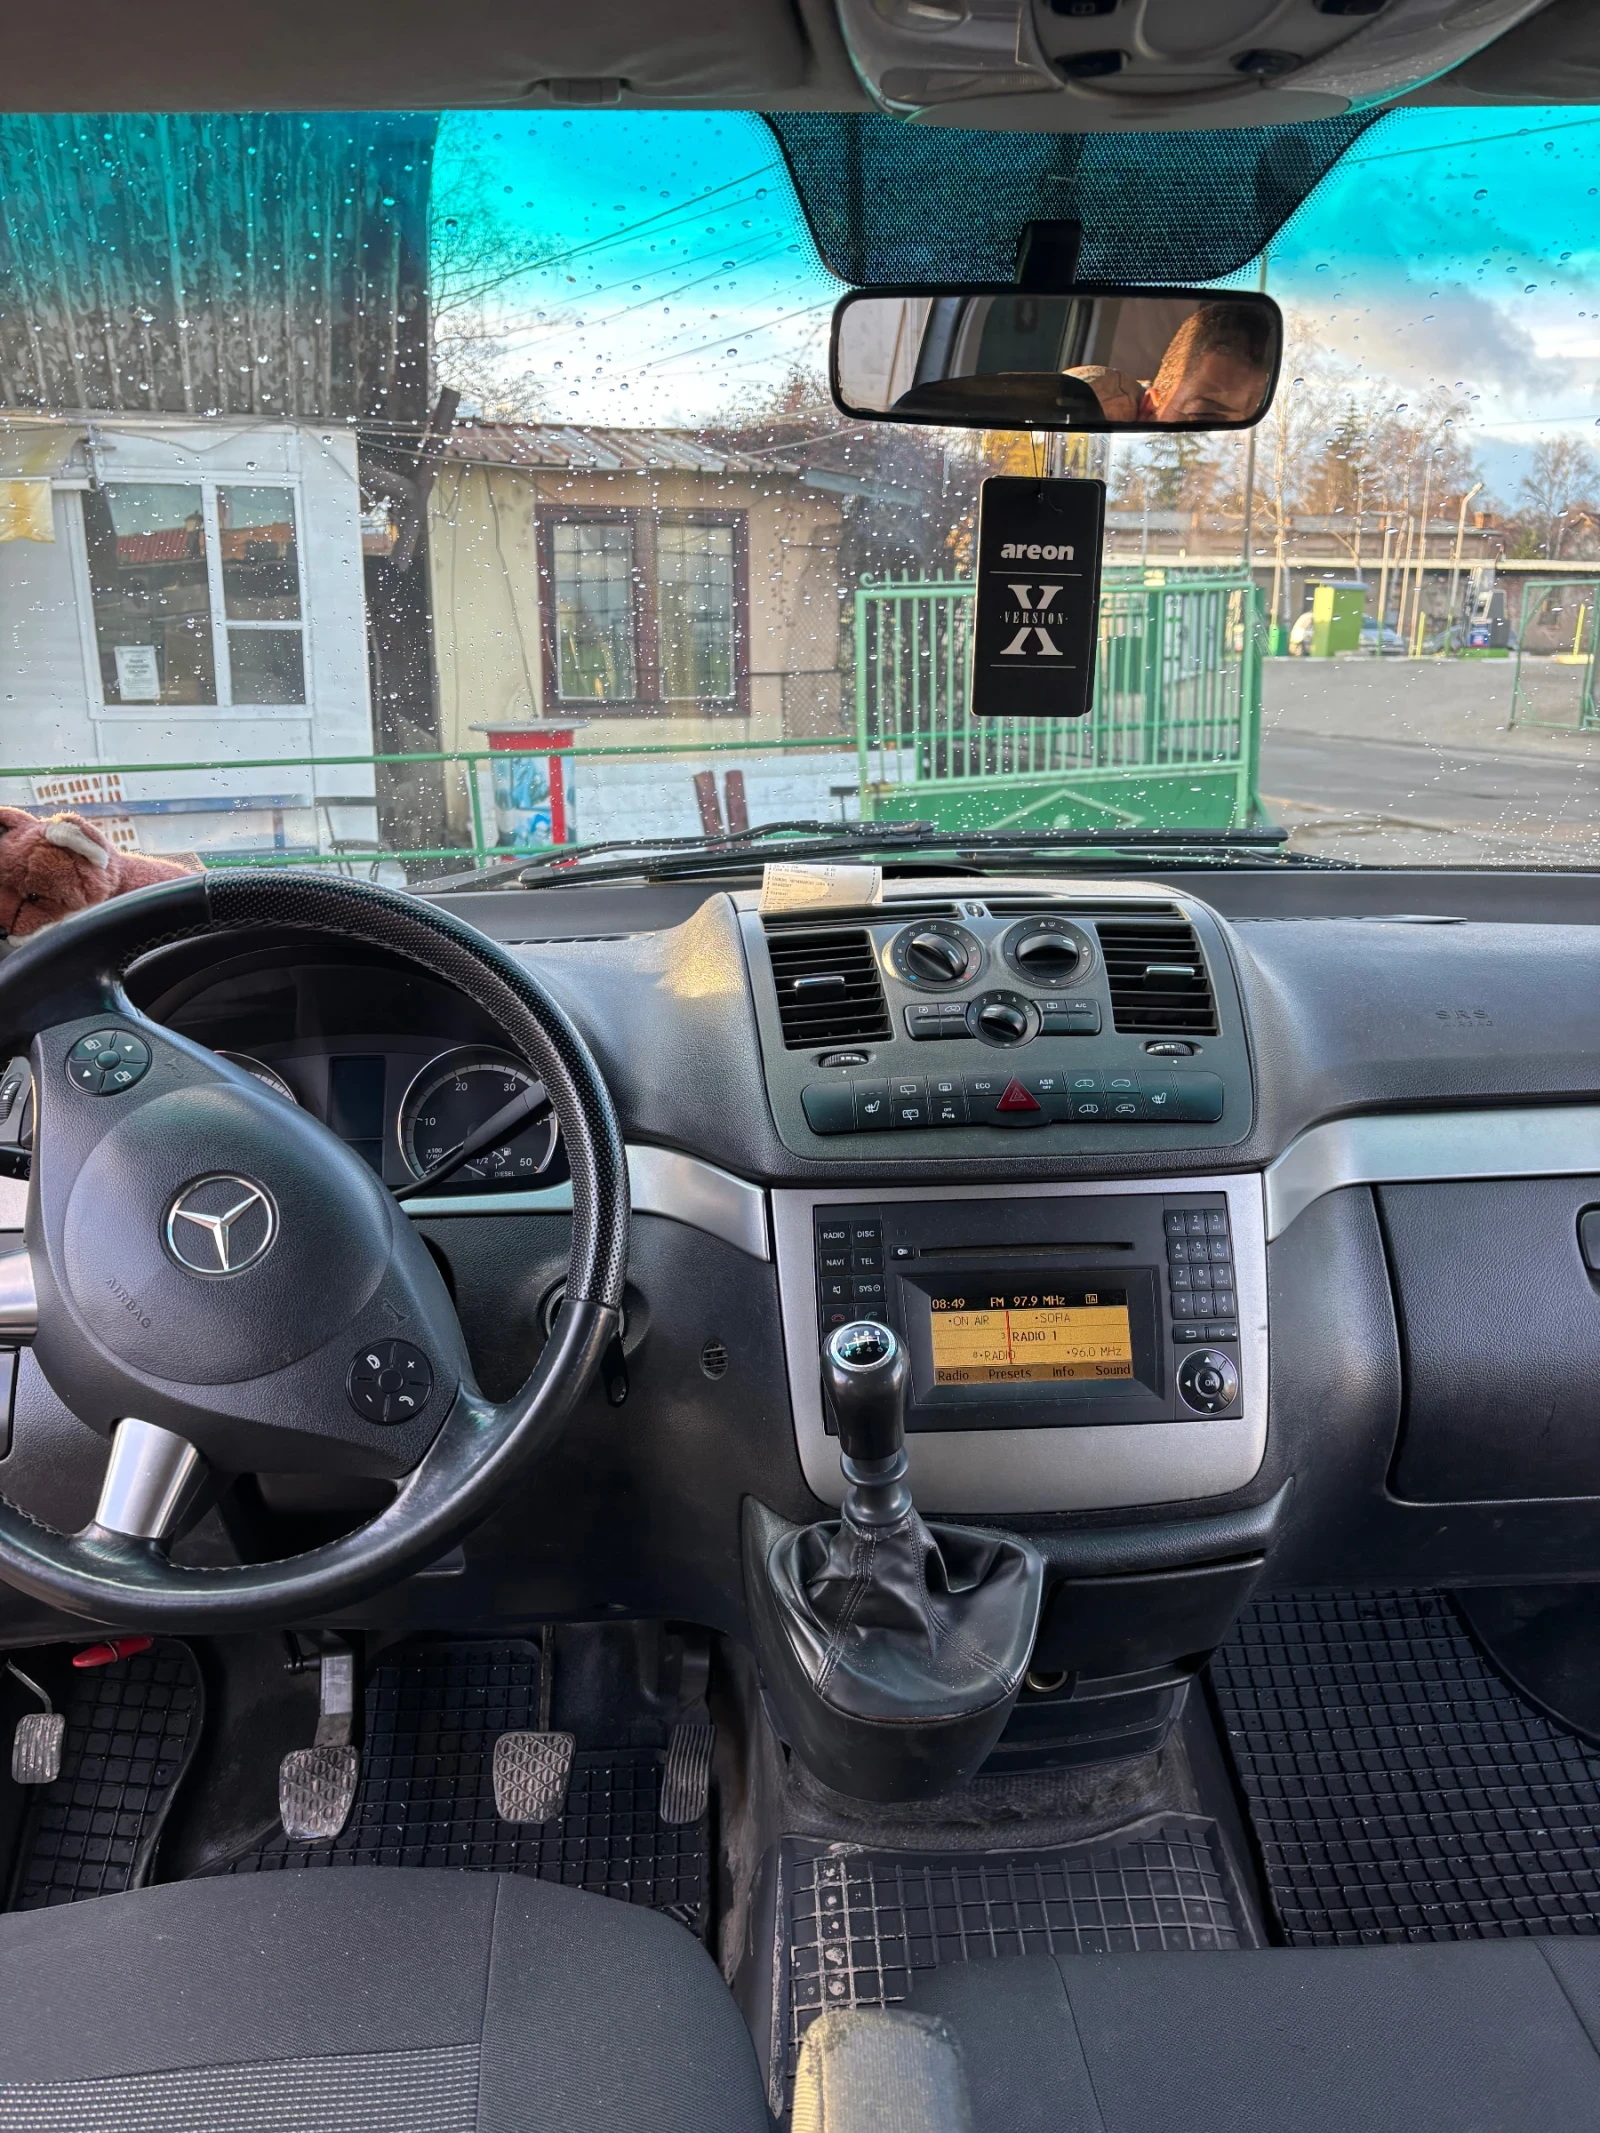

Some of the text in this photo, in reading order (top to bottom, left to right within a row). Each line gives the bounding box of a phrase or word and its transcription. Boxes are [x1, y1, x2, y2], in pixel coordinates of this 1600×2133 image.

[1000, 543, 1075, 561] areon
[1003, 610, 1064, 626] VERSION
[455, 1082, 468, 1092] 20
[503, 1082, 516, 1092] 30
[975, 1082, 991, 1090] ECO
[424, 1117, 437, 1126] 10
[476, 1157, 489, 1165] 1/2
[519, 1157, 533, 1167] 50
[494, 1170, 516, 1178] DIESEL
[1193, 1215, 1199, 1223] 2
[1213, 1214, 1219, 1222] 3
[823, 1231, 846, 1240] RADIO
[857, 1230, 875, 1238] DISC
[1216, 1241, 1221, 1249] 6
[826, 1258, 845, 1266] NAVI
[860, 1257, 874, 1265] TEL
[859, 1284, 873, 1293] SYS
[103, 1277, 152, 1329] AIRBAG
[932, 1298, 966, 1309] 08:49
[990, 1297, 1005, 1308] FM
[1013, 1296, 1038, 1307] 97.9
[1042, 1295, 1066, 1306] MHz
[1201, 1296, 1207, 1304] 0
[953, 1314, 990, 1326] ON AIR
[1039, 1312, 1071, 1324] SOFIA
[1012, 1330, 1046, 1342] RADIO
[1052, 1330, 1057, 1341] 1
[1219, 1328, 1225, 1337] C
[856, 1347, 862, 1355] 2
[984, 1349, 1016, 1361] RADIO
[1071, 1346, 1122, 1358] 96.0 MHz
[938, 1363, 1131, 1382] Radio Presets Info Sound
[1204, 1379, 1216, 1387] OK
